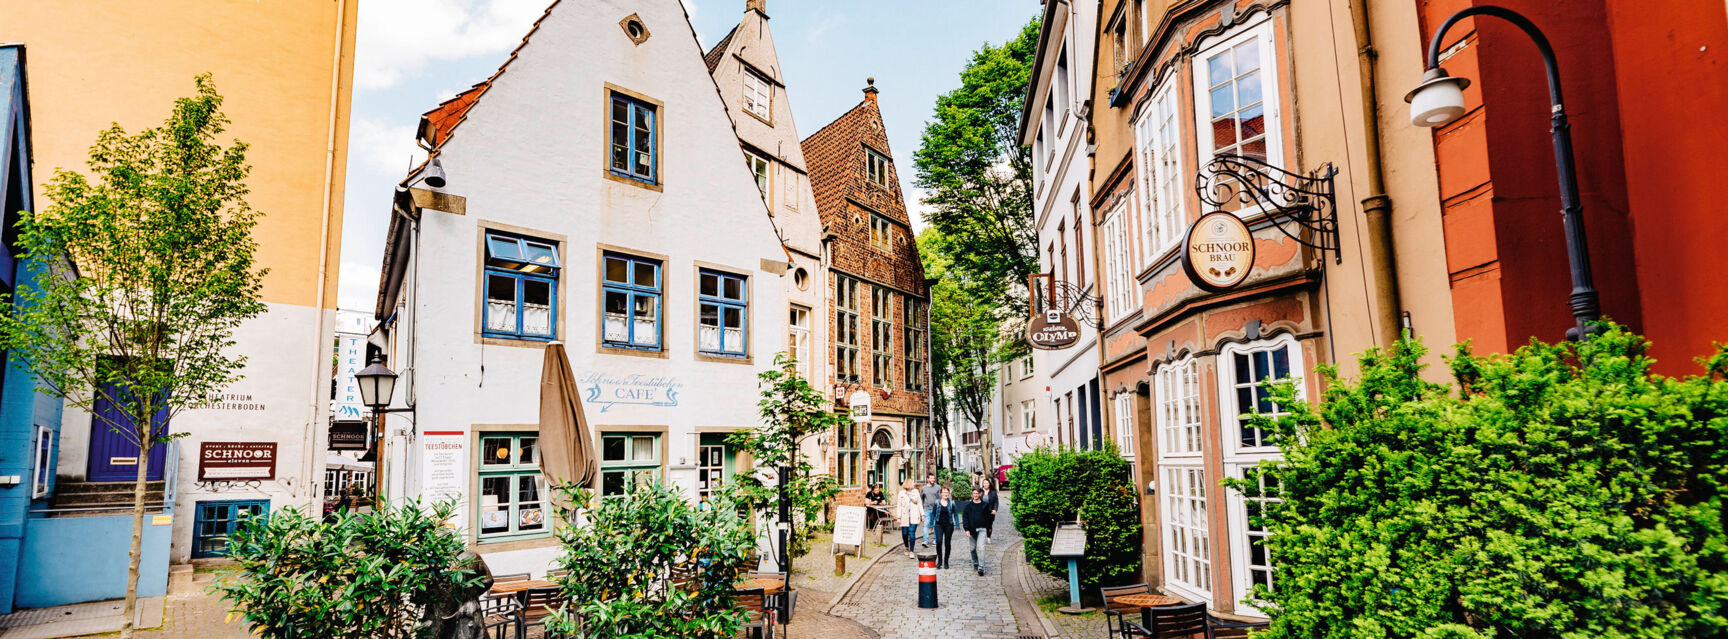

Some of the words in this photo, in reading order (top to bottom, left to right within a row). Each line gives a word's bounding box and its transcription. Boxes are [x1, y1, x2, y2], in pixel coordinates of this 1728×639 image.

[1191, 242, 1250, 253] SCHNOOR
[346, 338, 358, 402] THEATER
[204, 393, 253, 401] HEATRIUM
[204, 449, 272, 459] SCHNOOR
